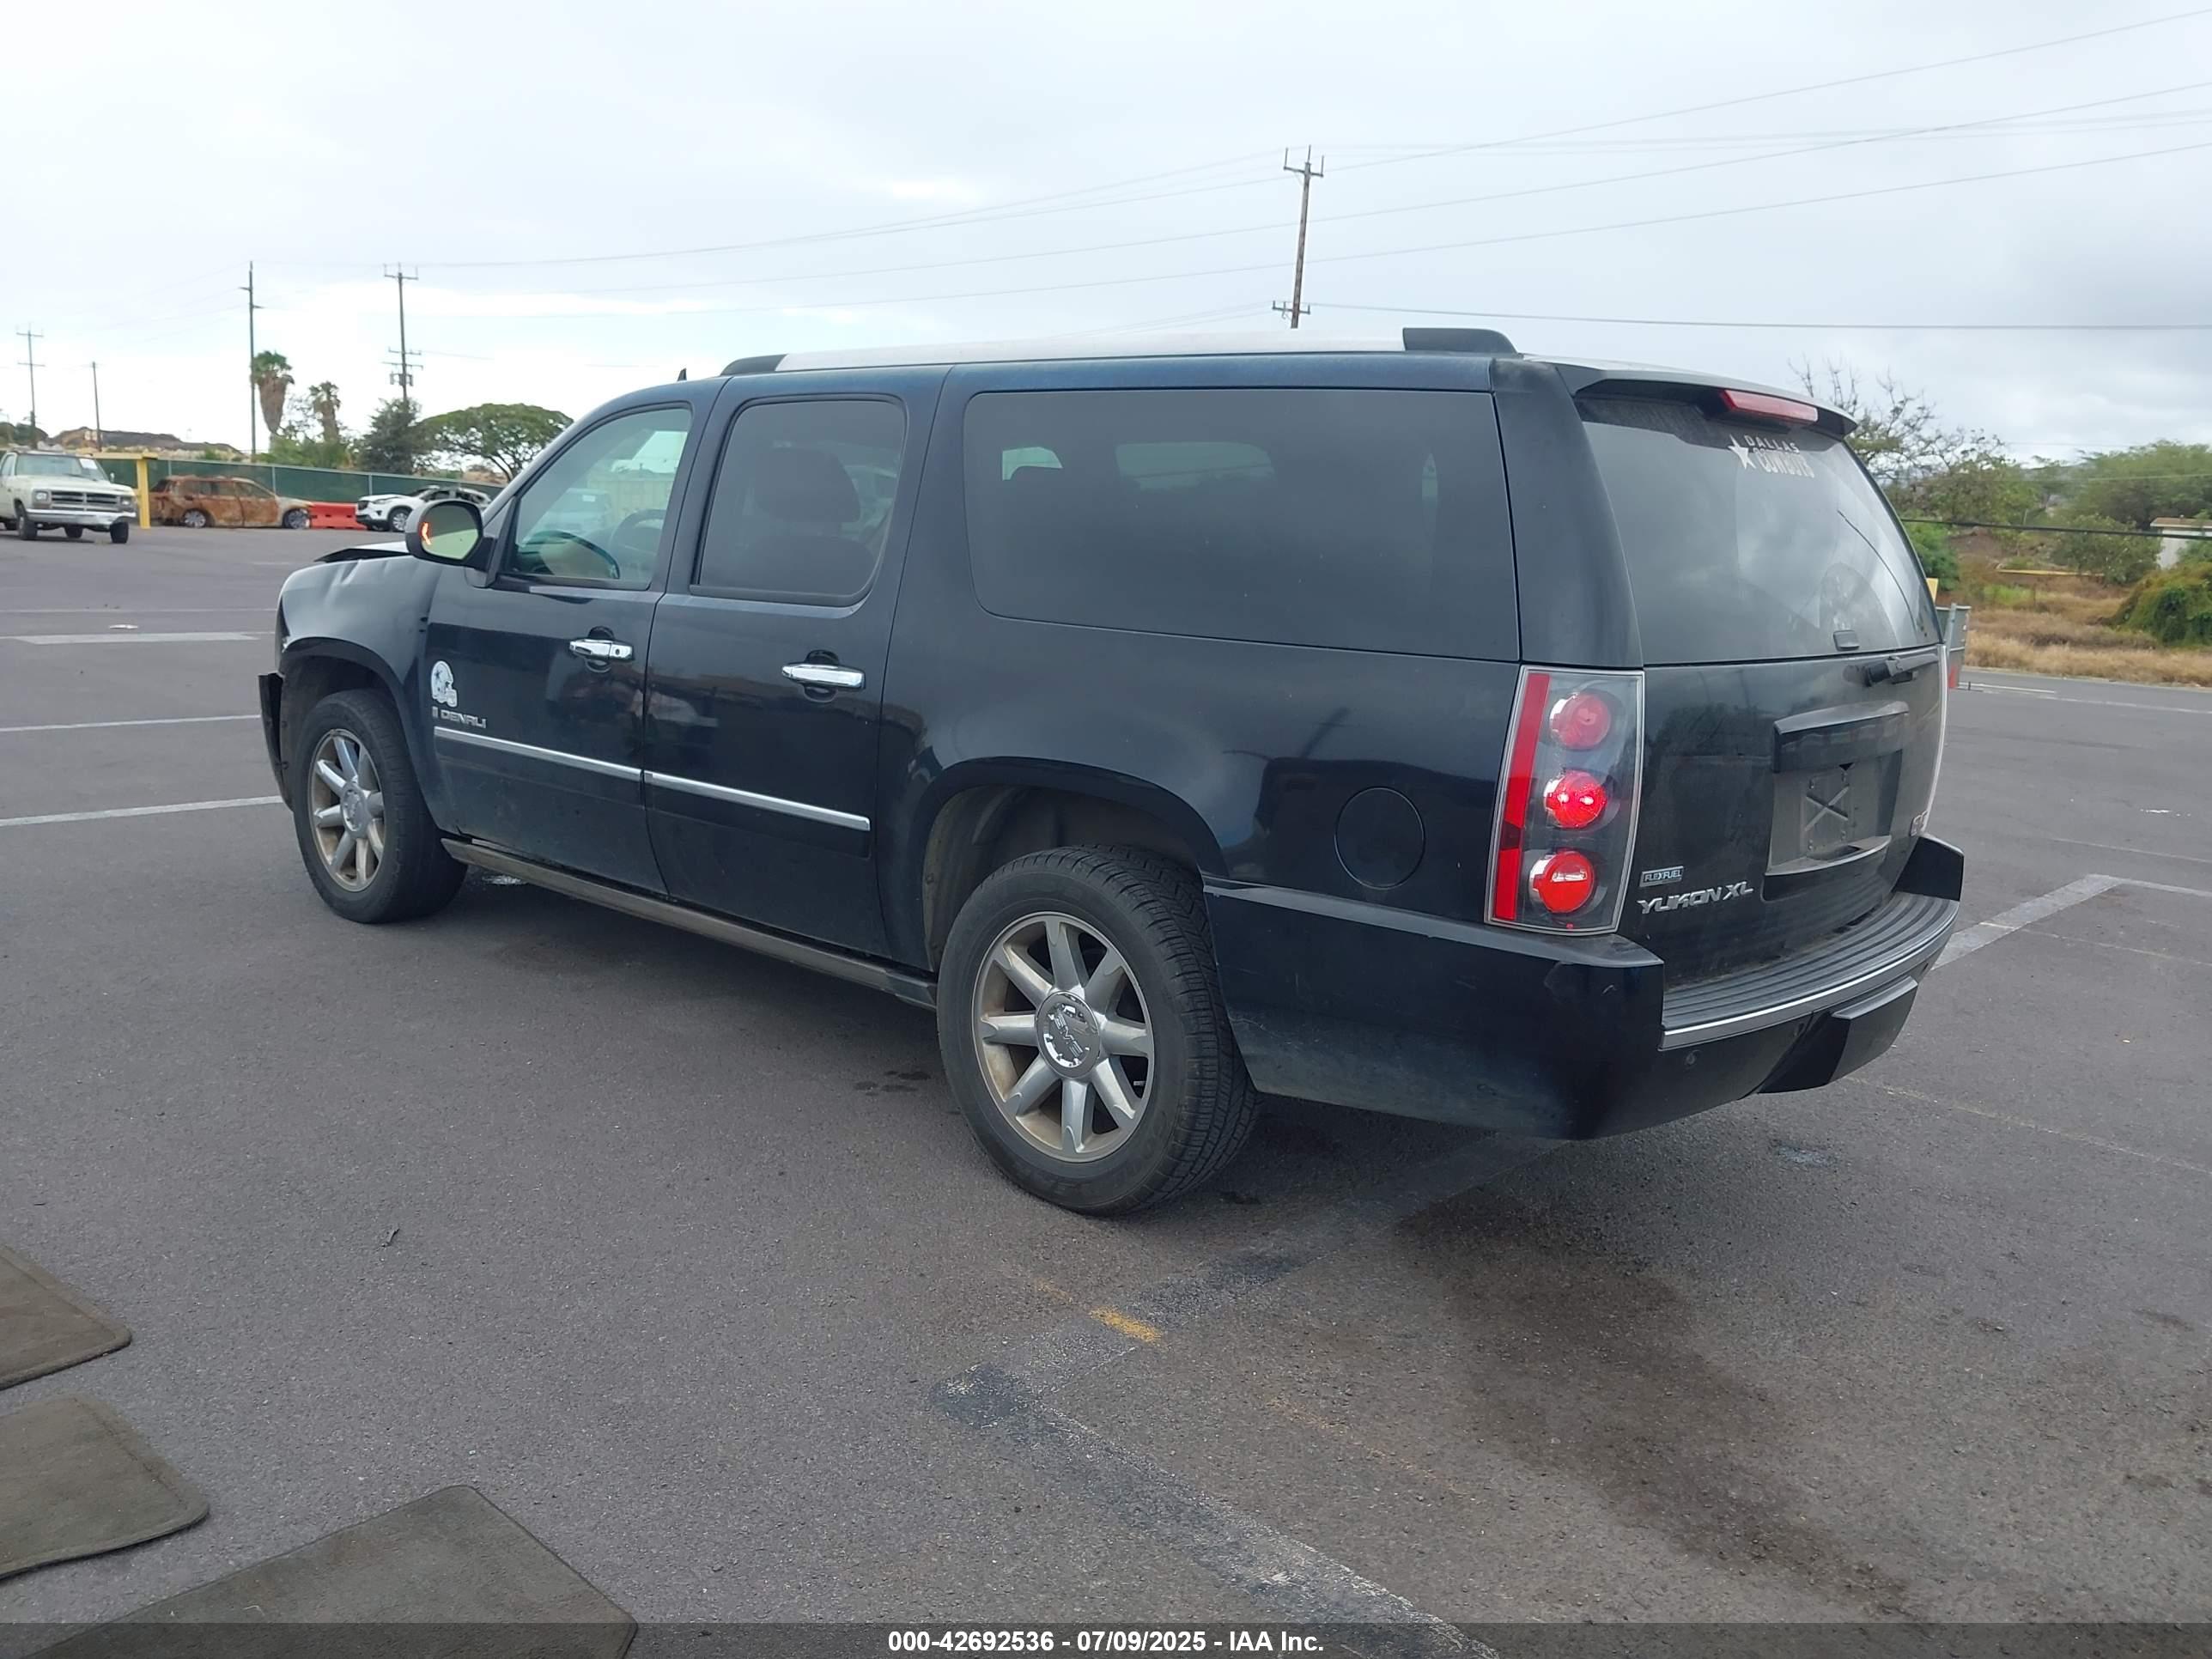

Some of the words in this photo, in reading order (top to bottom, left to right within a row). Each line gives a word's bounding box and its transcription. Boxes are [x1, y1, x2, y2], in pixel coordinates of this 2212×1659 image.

[1744, 434, 1800, 453] DALLAS
[441, 709, 487, 729] DENALI
[1637, 886, 1723, 915] YUKON
[1723, 880, 1753, 901] XL
[1054, 1013, 1084, 1058] GMC
